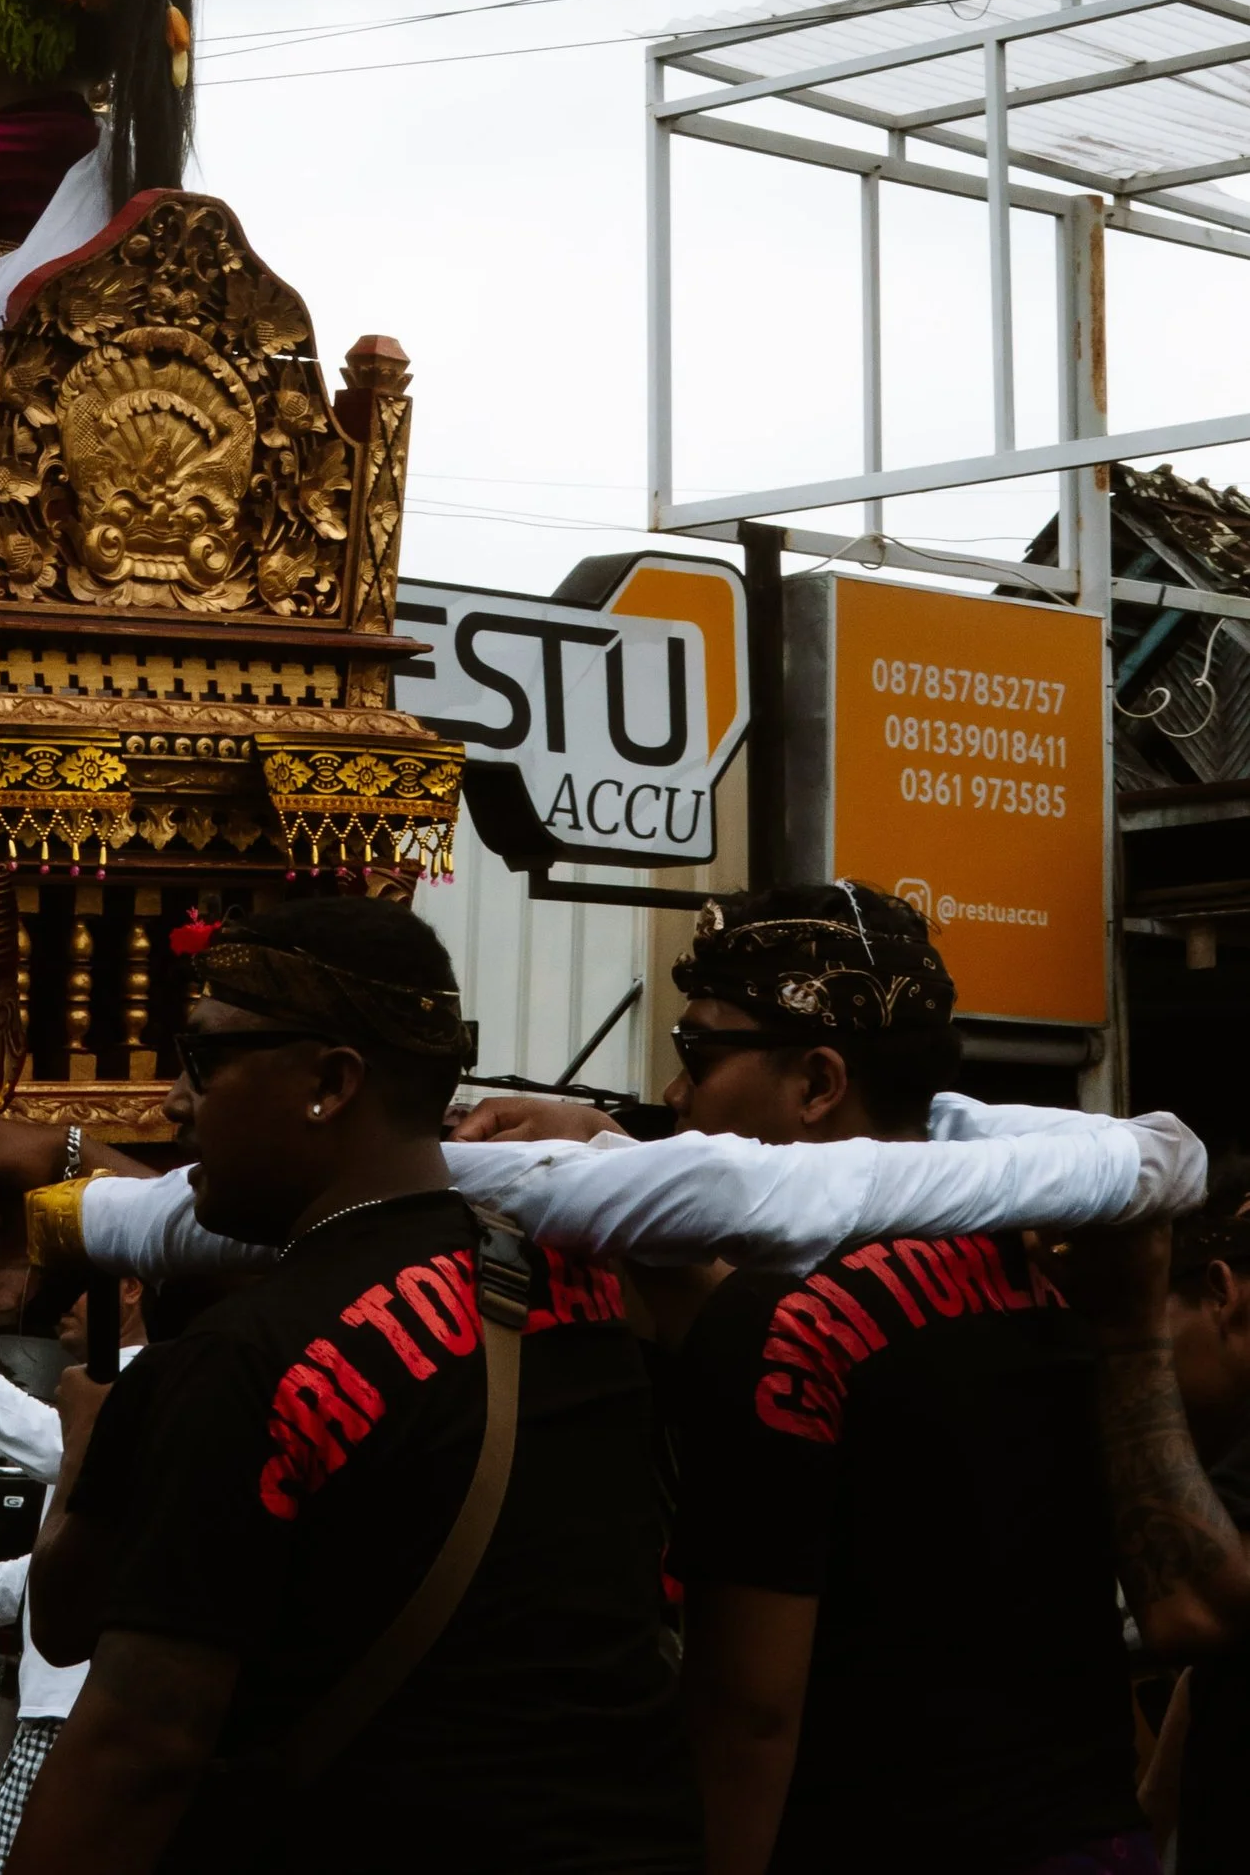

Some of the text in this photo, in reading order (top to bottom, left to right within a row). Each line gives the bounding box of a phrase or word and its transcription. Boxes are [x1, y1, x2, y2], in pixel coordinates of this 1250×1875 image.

[872, 658, 1066, 715] 087857852757
[885, 714, 1067, 769] 081339018411
[543, 773, 706, 844] ACCU
[900, 767, 1066, 818] 0361 973585
[936, 894, 1049, 926] @restuaccu
